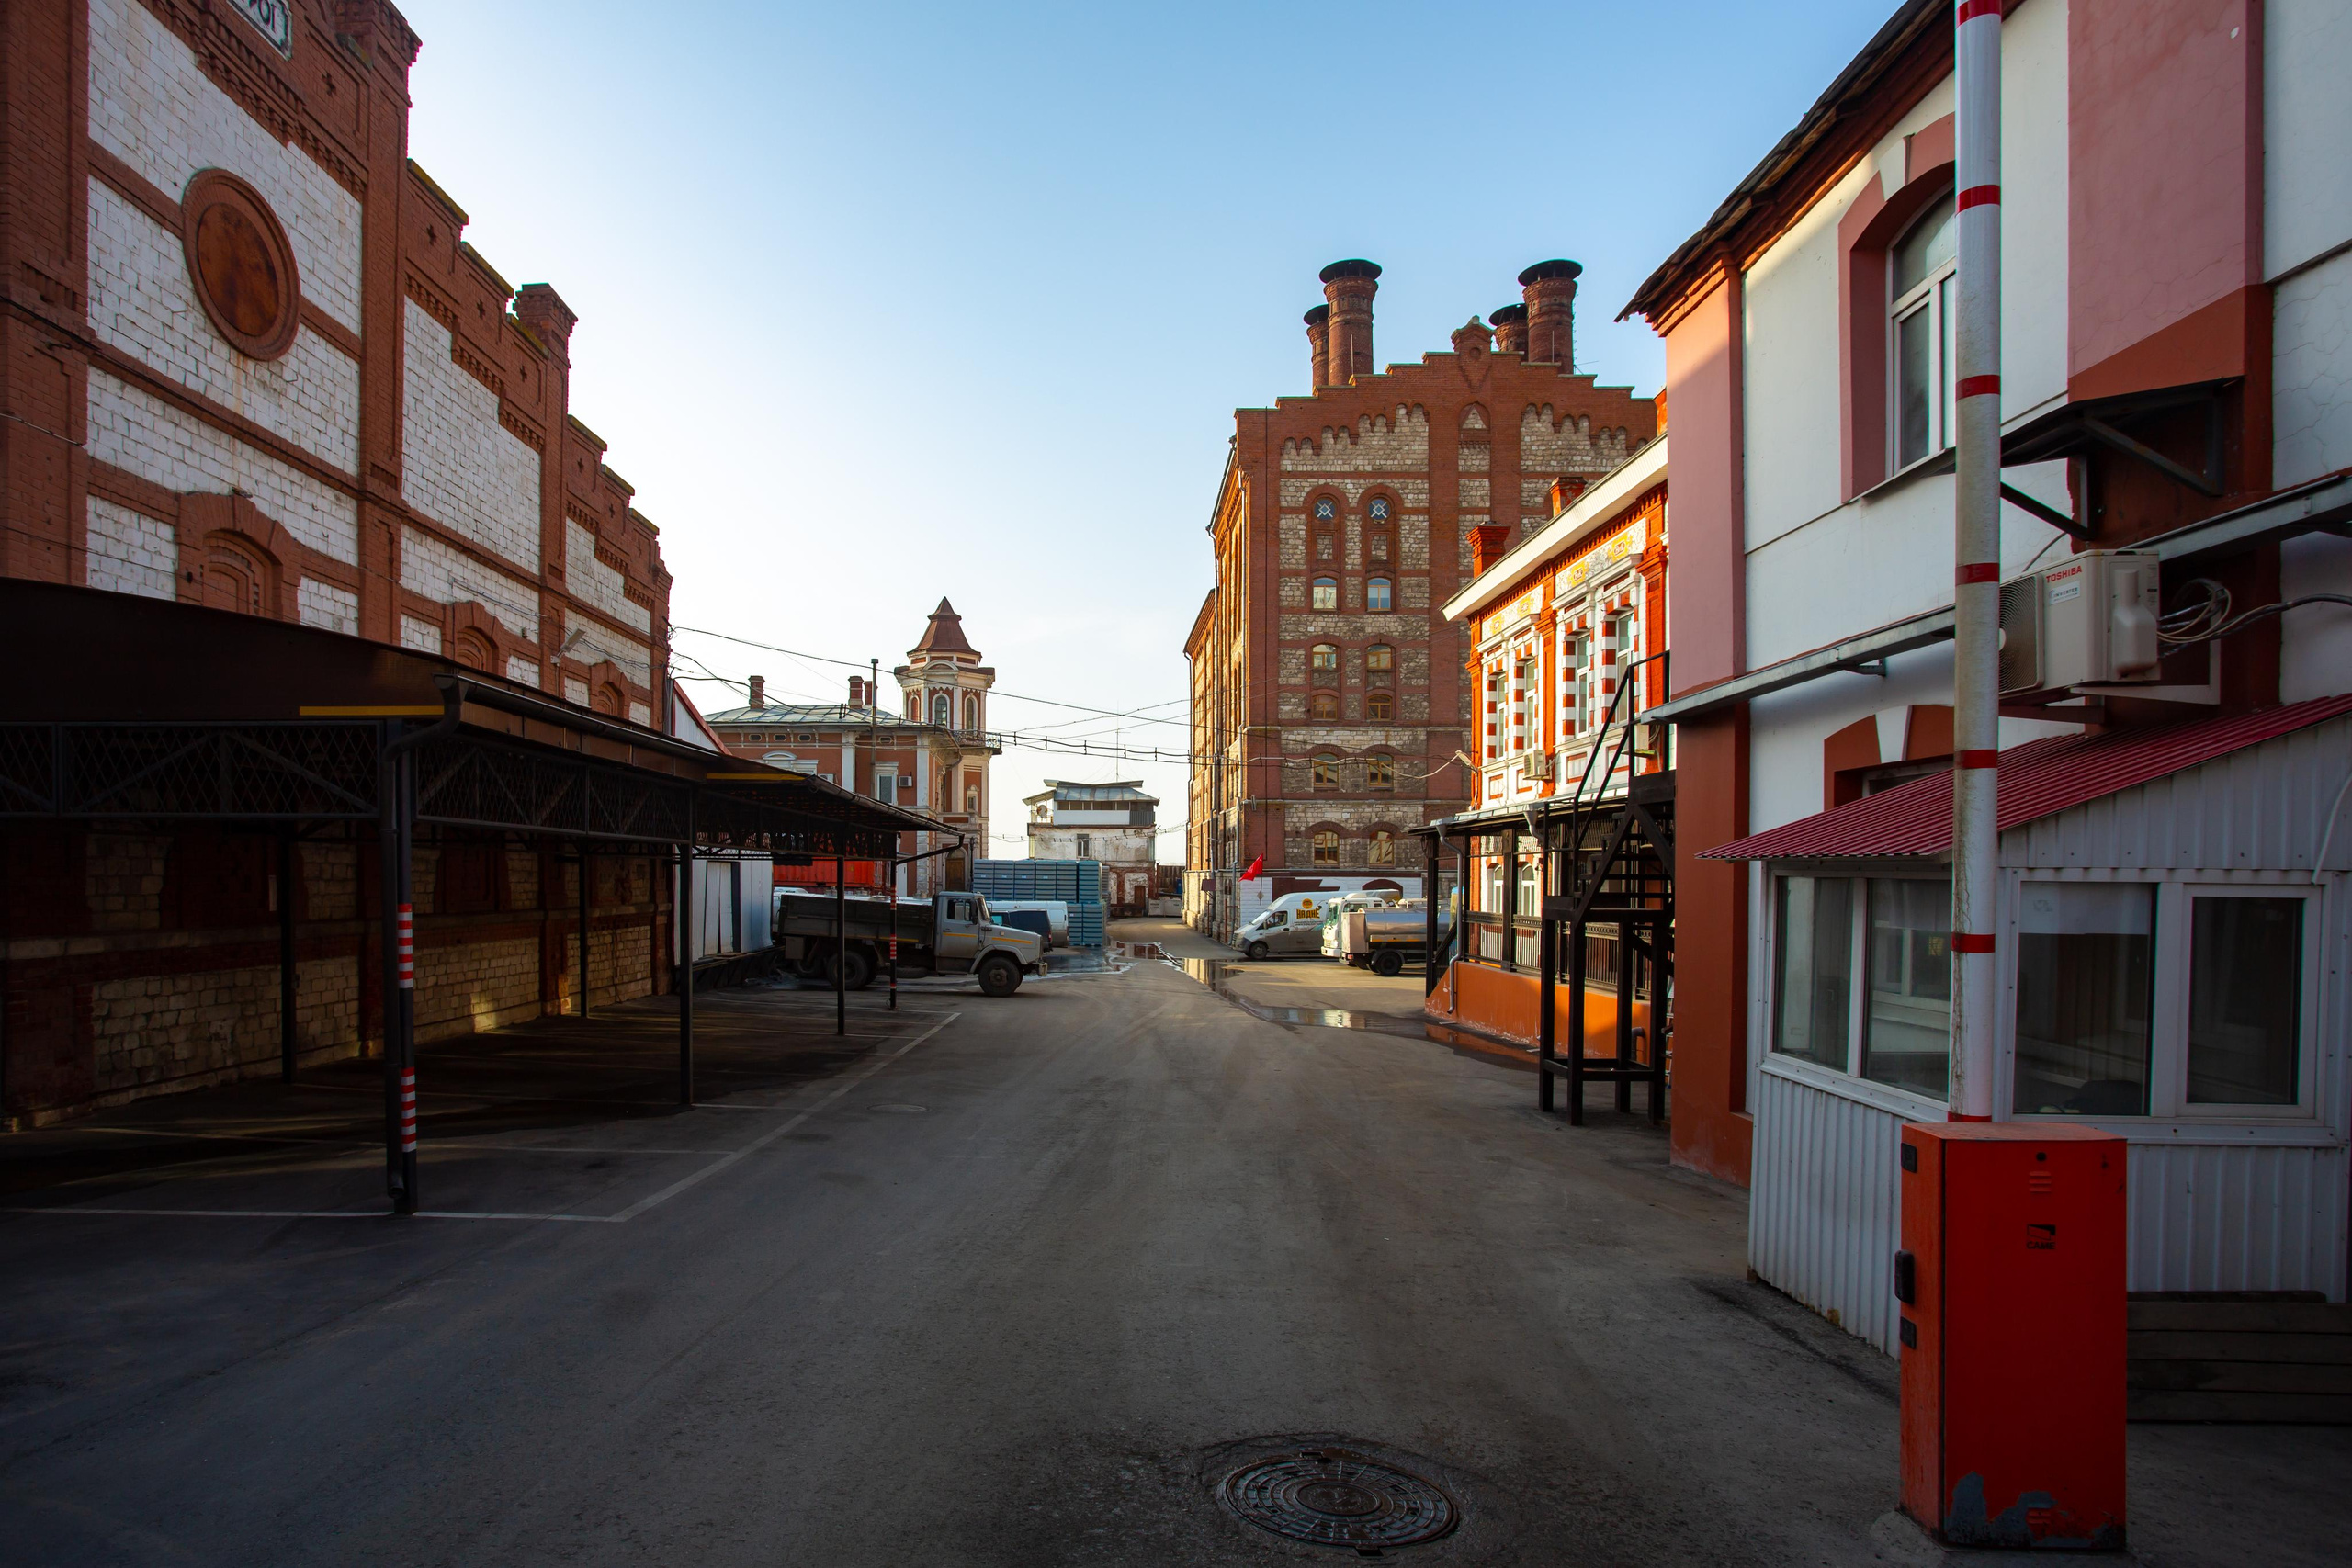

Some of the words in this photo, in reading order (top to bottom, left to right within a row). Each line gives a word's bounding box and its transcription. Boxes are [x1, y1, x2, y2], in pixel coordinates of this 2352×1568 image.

[2046, 565, 2082, 583] TOSHIBA
[1296, 909, 1306, 919] НА
[2026, 1241, 2056, 1250] CAME
